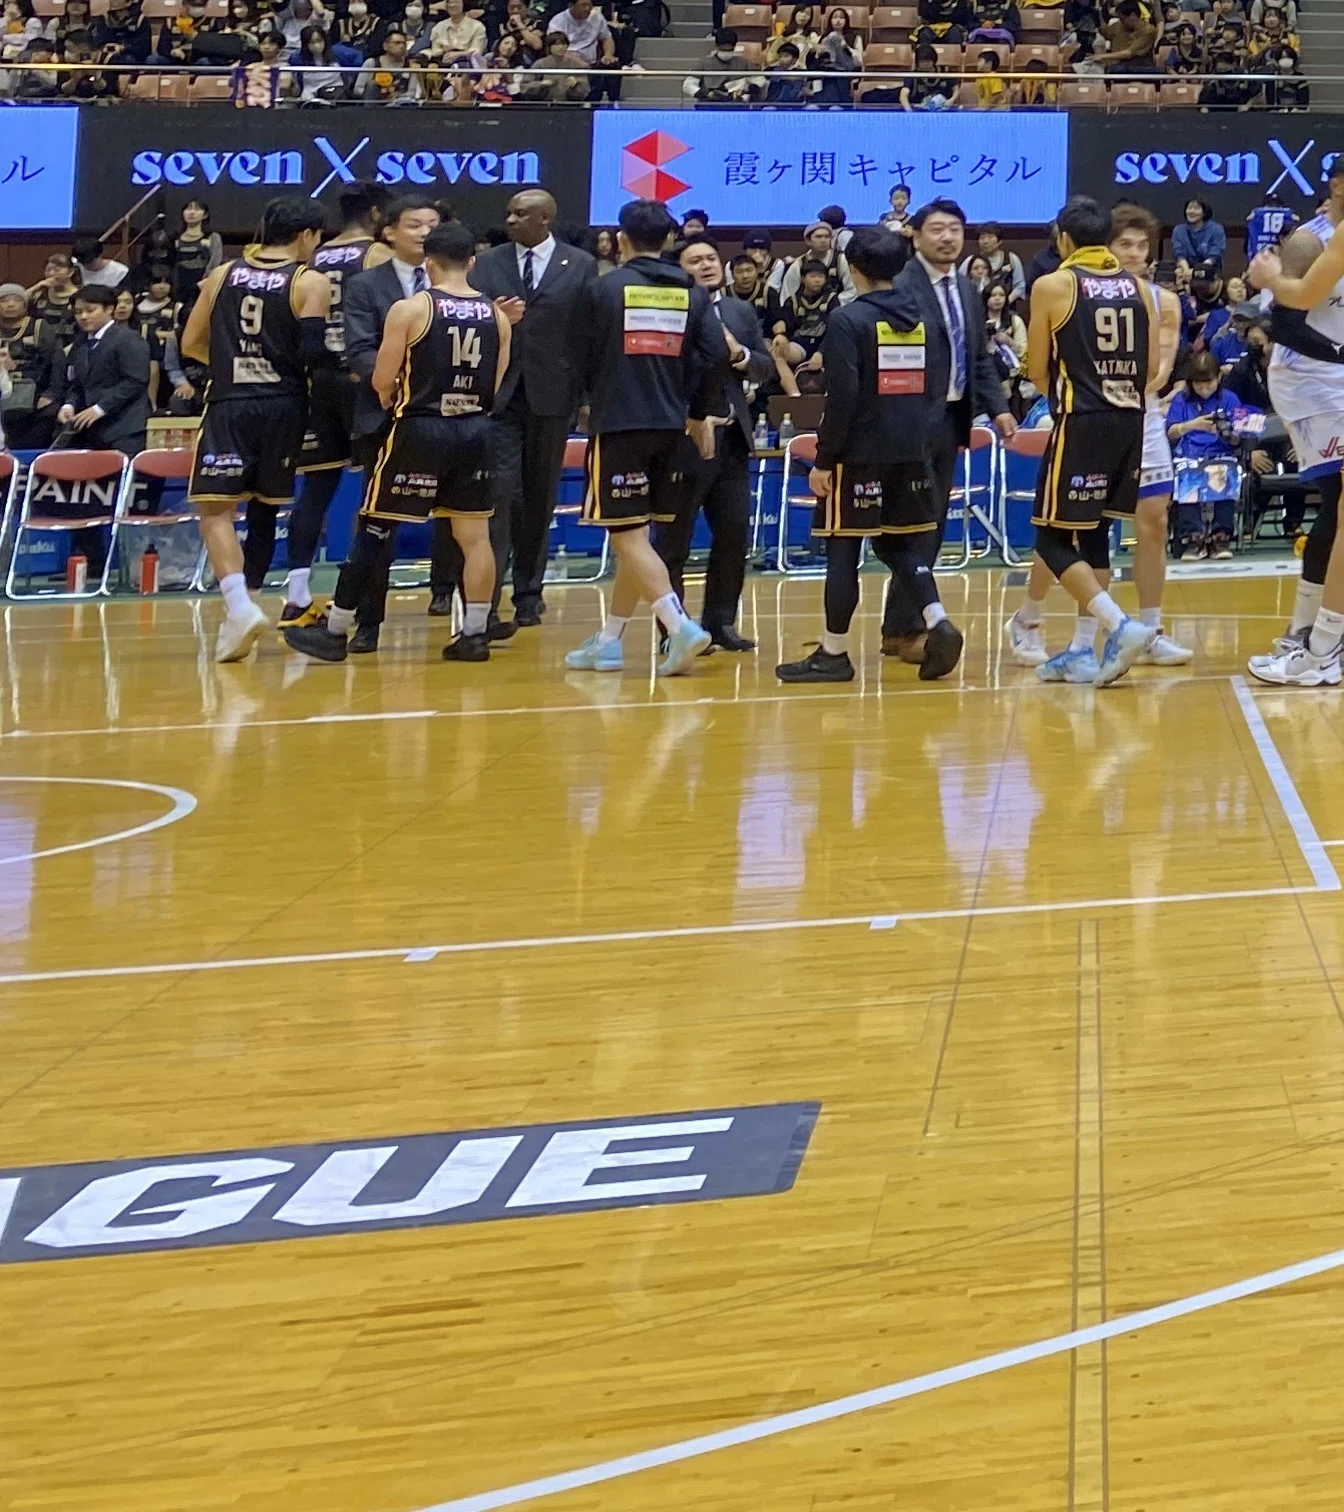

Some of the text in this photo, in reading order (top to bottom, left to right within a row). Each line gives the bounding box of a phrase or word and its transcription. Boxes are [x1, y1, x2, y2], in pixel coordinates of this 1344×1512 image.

[131, 150, 305, 186] seven
[375, 150, 541, 186] seven
[724, 151, 1043, 187] 霞ヶ関キャピタル
[1114, 150, 1260, 185] seven
[231, 267, 287, 291] やまや
[1083, 278, 1137, 300] やまや
[240, 295, 265, 336] 9
[438, 299, 493, 320] やまや
[447, 326, 483, 369] 14
[1094, 307, 1136, 352] 91
[0, 1117, 735, 1249] GUE
